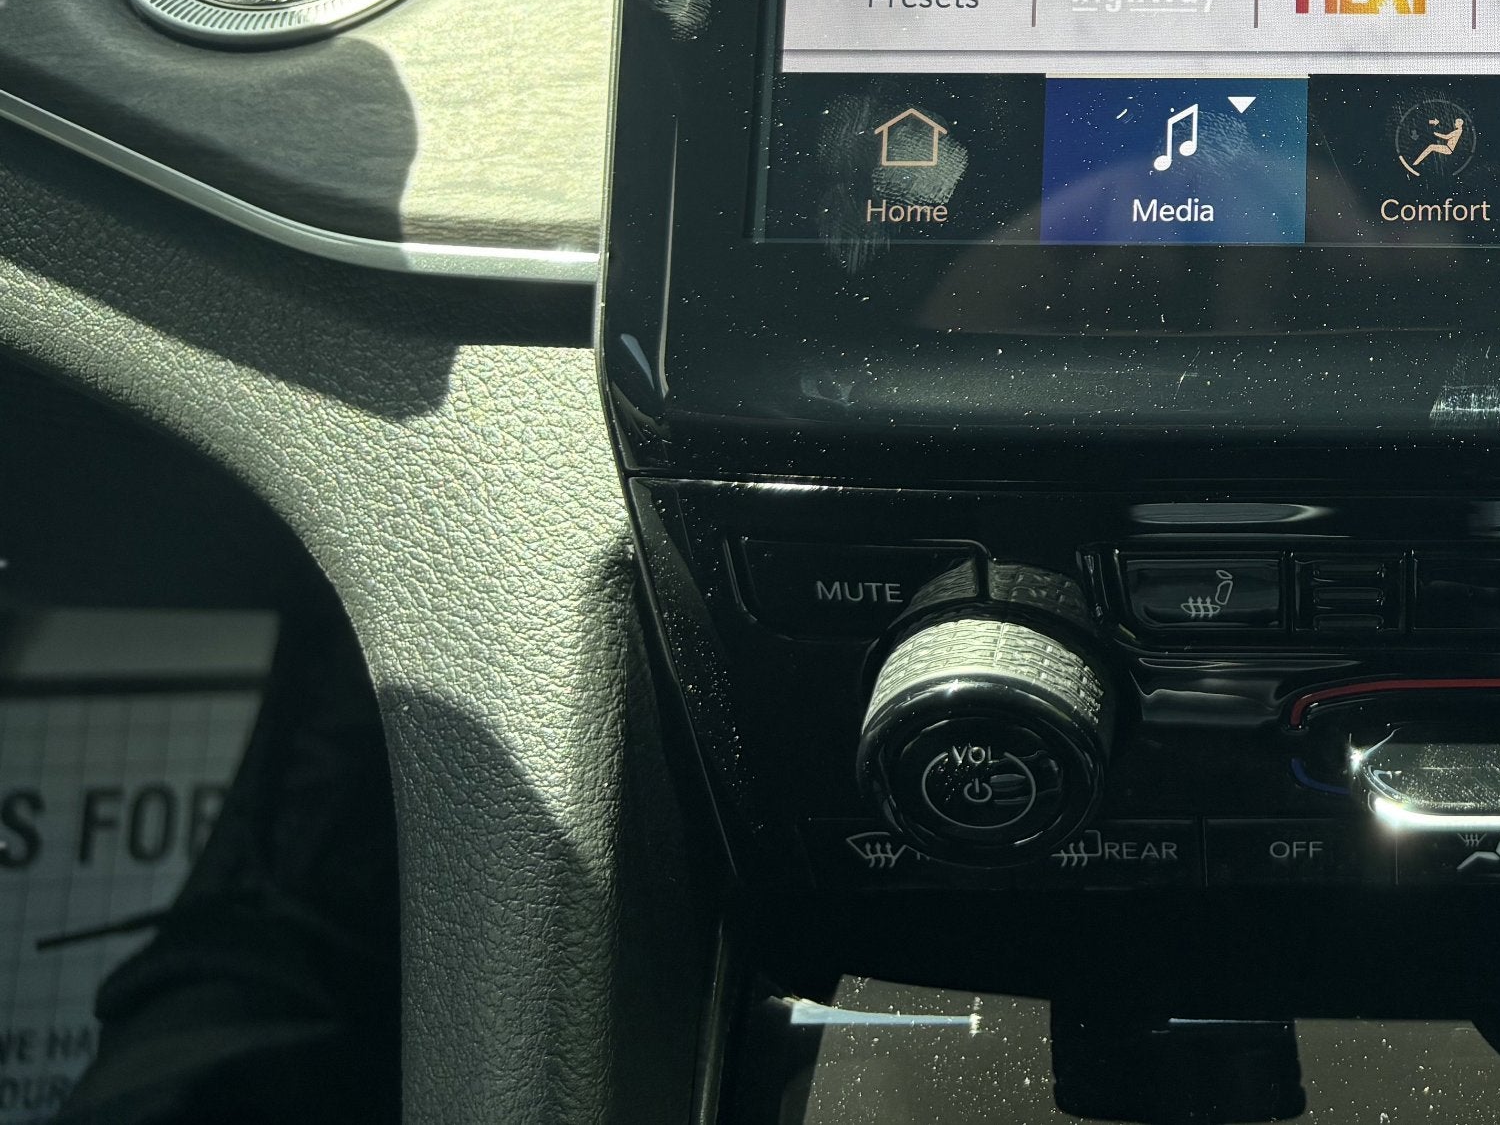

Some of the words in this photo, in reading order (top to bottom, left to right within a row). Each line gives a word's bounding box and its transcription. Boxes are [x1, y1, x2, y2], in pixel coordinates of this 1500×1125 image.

[865, 199, 949, 224] Home
[1132, 197, 1215, 224] Media
[1379, 197, 1491, 224] Comfort
[816, 580, 904, 604] MUTE
[951, 745, 999, 764] VOL
[1104, 841, 1178, 860] REAR
[1269, 841, 1323, 860] OFF
